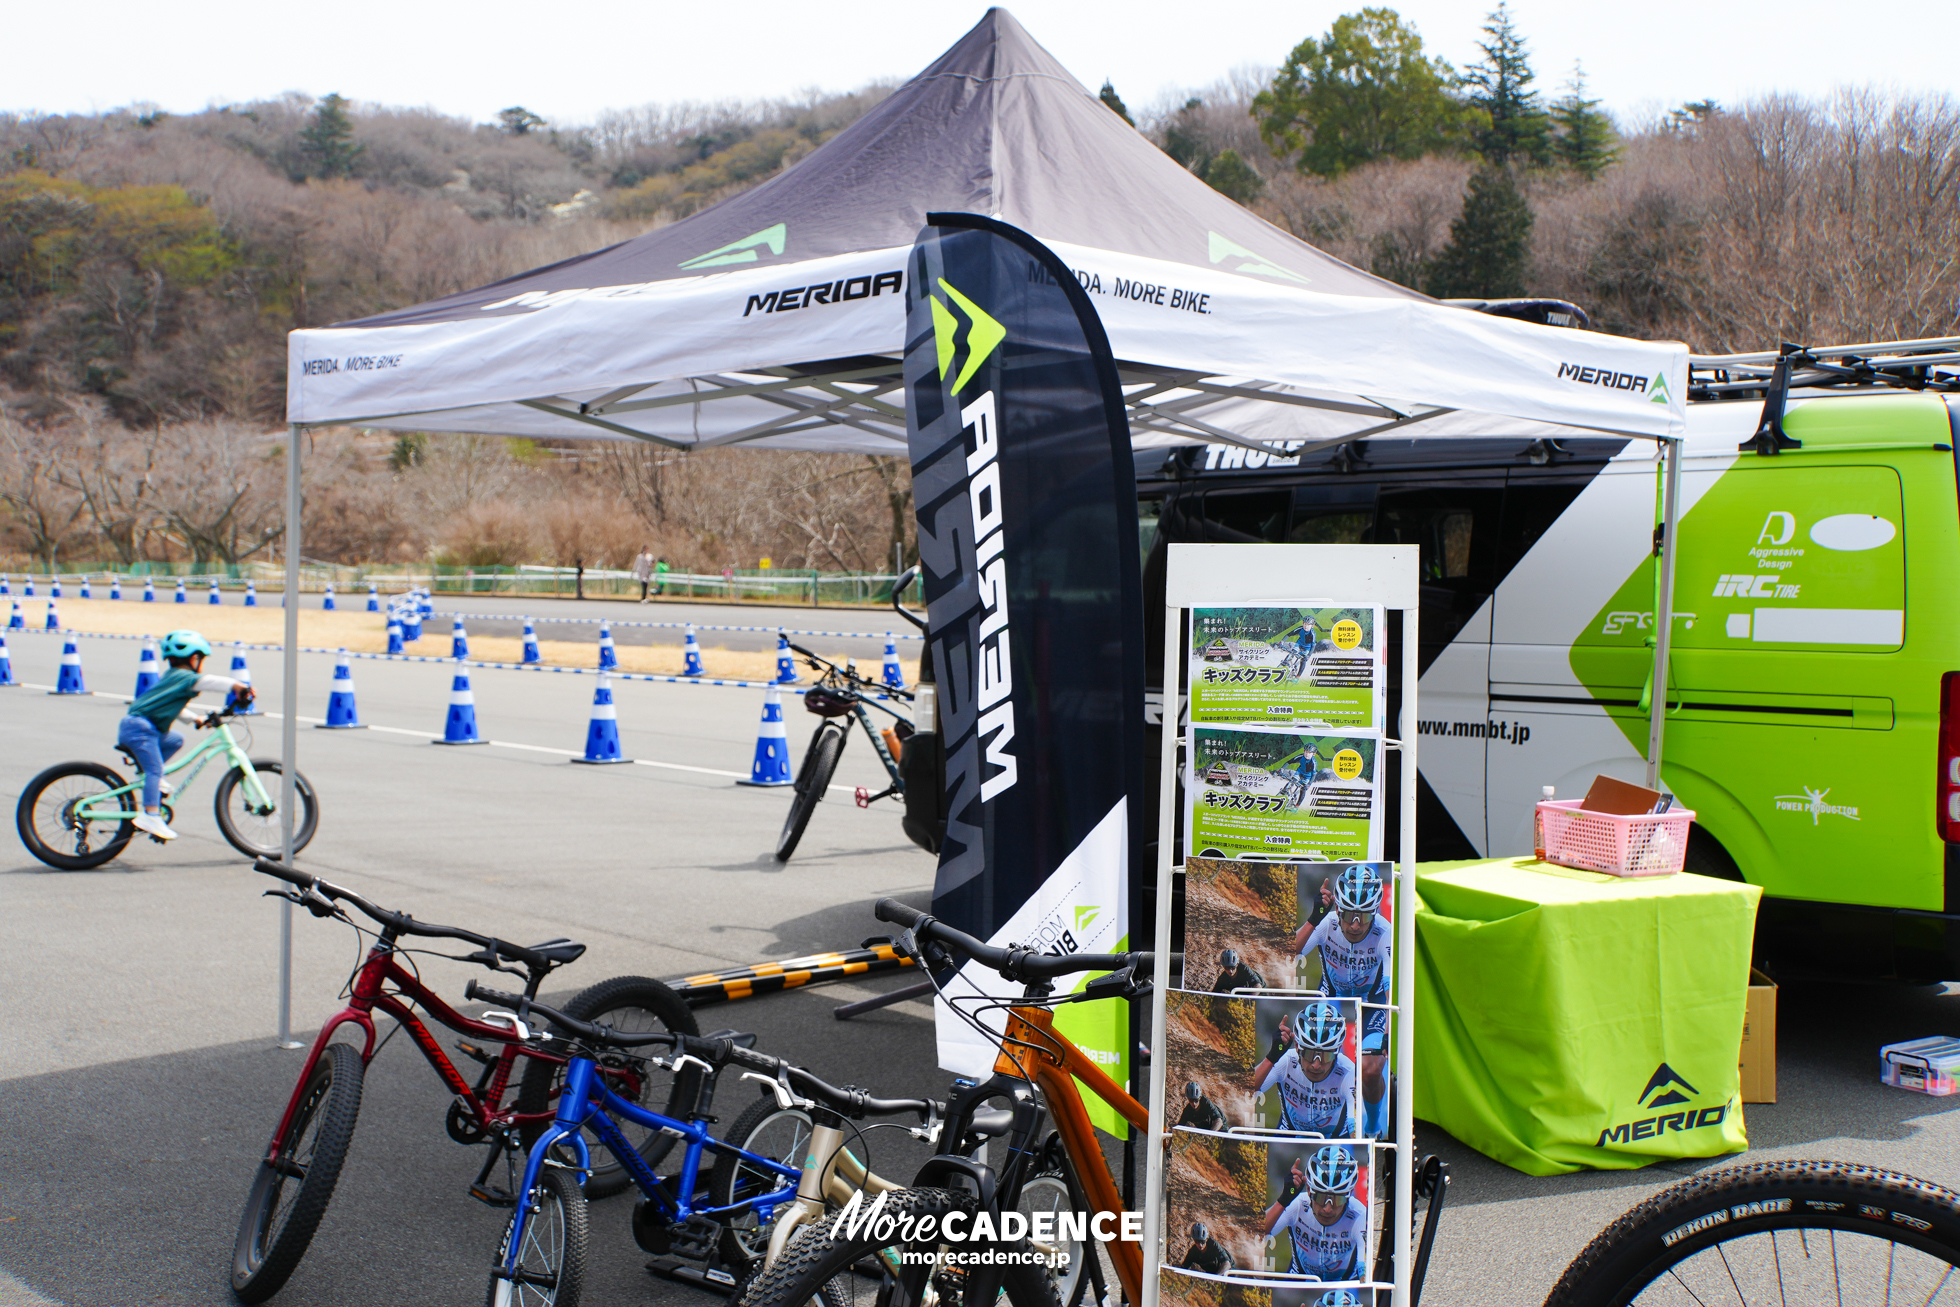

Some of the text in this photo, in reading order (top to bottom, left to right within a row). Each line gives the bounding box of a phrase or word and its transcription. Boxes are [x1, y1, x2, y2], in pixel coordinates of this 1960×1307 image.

[743, 270, 903, 317] MERIDA
[1114, 276, 1166, 306] MORE
[1170, 288, 1212, 315] BIKE.
[1546, 311, 1572, 326] THULE
[344, 356, 377, 372] MORE
[1556, 361, 1648, 393] MERIDA
[1748, 547, 1805, 559] Aggressive
[1757, 559, 1793, 570] Design
[1773, 584, 1802, 599] TIRE
[1202, 667, 1287, 685] キッズクラブ
[1417, 720, 1531, 745] ww.mmbt.jp
[1204, 792, 1286, 813] キッズクラブ
[1775, 801, 1858, 816] POWER PRODUCTION
[1325, 944, 1377, 966] BAHRAIN
[408, 1020, 471, 1095] MERIDA
[1284, 1081, 1341, 1105] BAHRAIN
[603, 1125, 655, 1182] MERIDA
[499, 1213, 517, 1256] KEND
[1661, 1209, 1729, 1247] REKON
[1731, 1198, 1792, 1219] RACE
[1295, 1225, 1352, 1249] BAHRAIN
